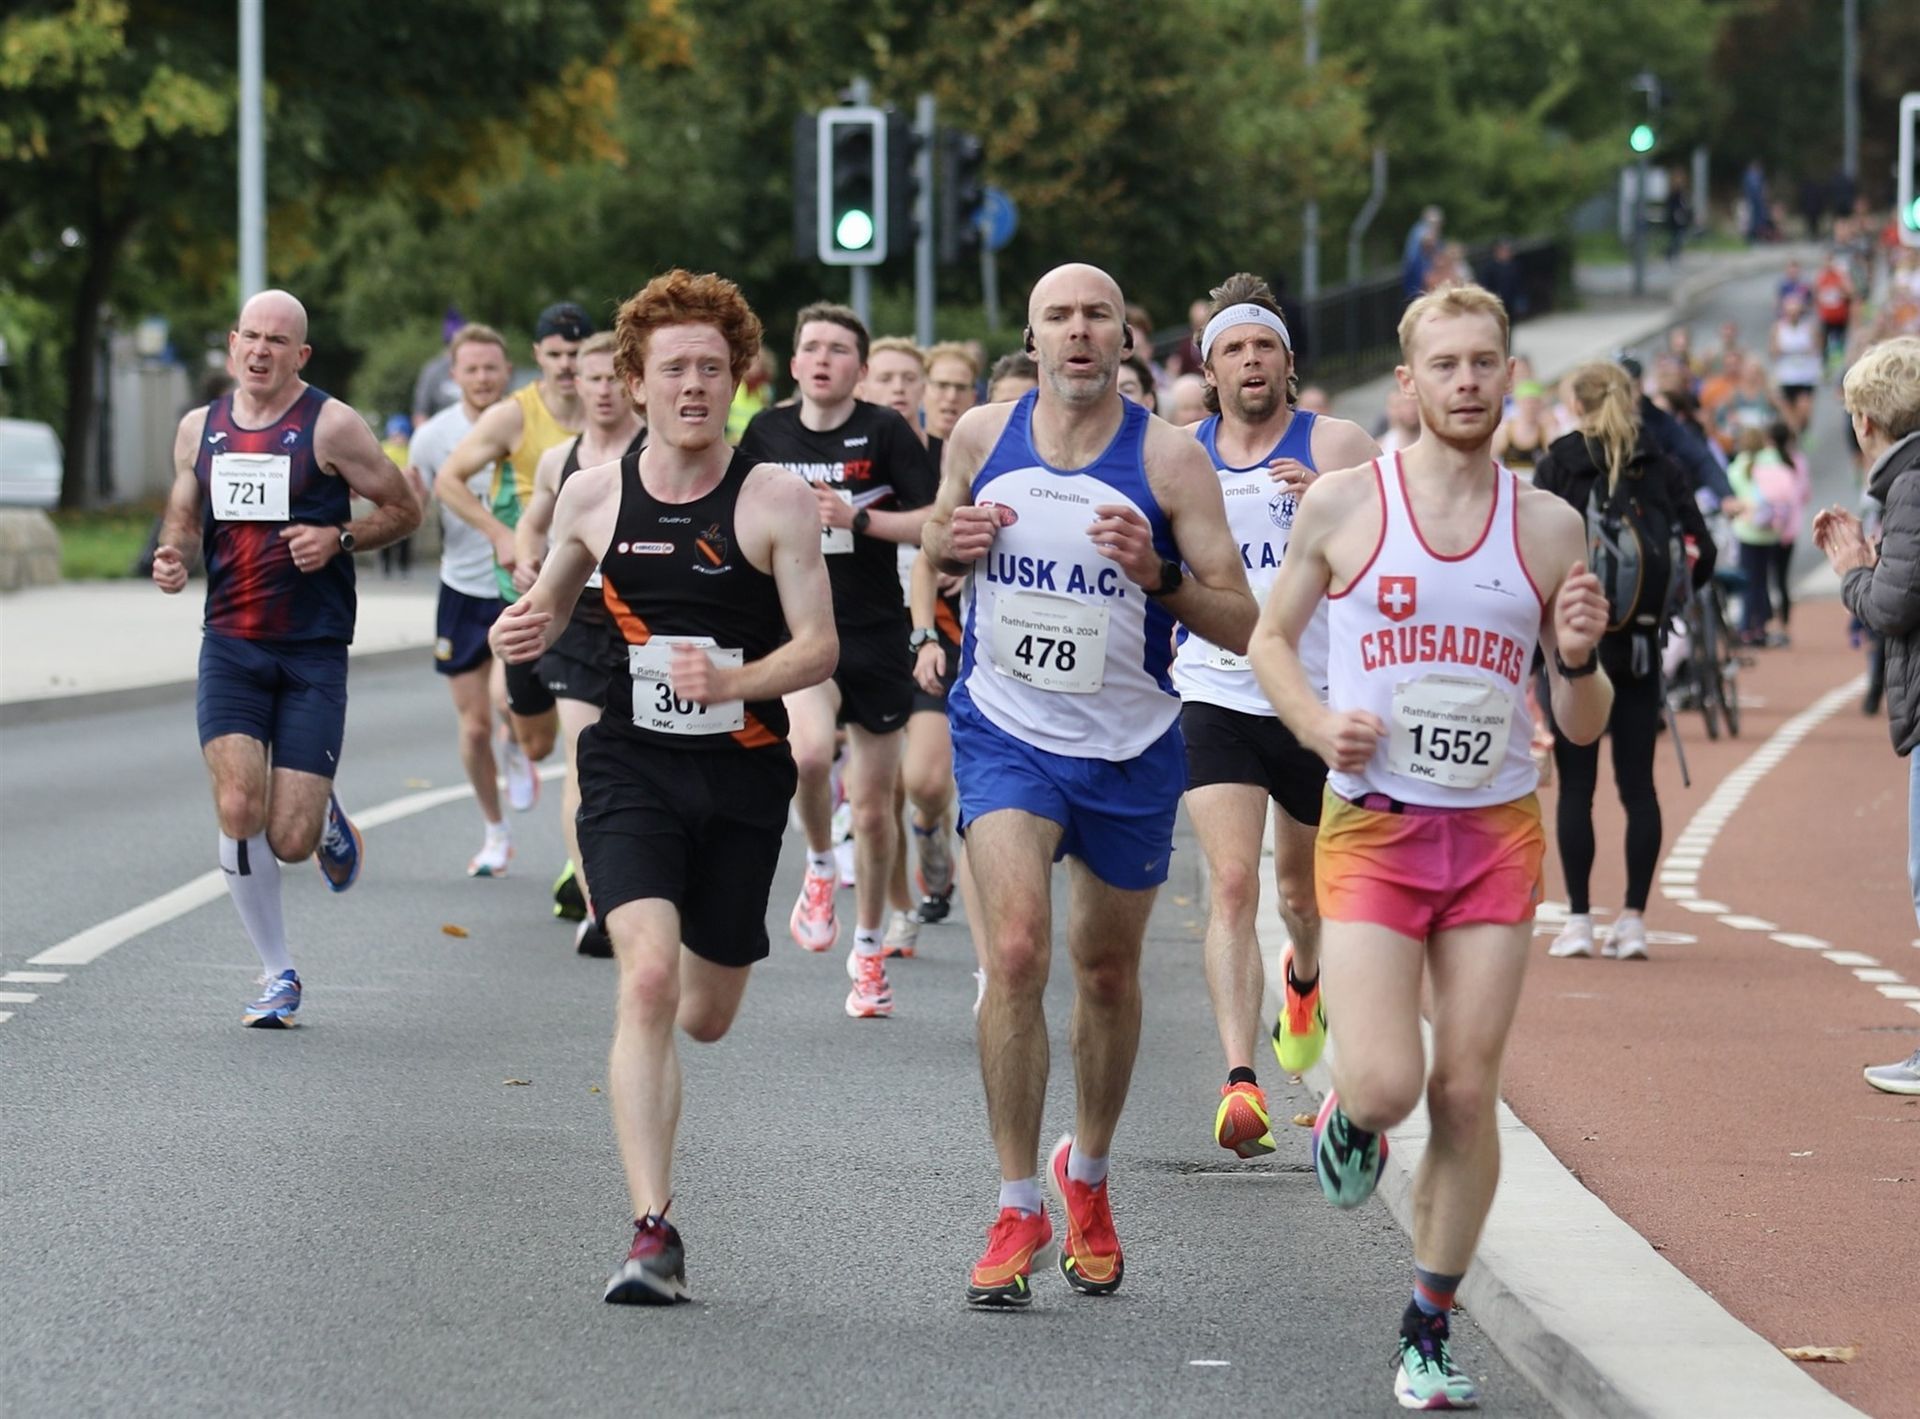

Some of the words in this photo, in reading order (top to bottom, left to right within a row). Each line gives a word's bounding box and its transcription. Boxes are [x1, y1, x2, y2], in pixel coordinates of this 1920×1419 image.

[228, 482, 265, 505] 721
[1029, 487, 1090, 505] O'Neills
[1224, 484, 1261, 497] oneills
[986, 551, 1058, 592] LUSK
[1066, 563, 1125, 598] A.C.
[1001, 615, 1060, 633] Rathfarnham
[1062, 626, 1074, 635] 5k
[1076, 627, 1099, 636] 2024
[1015, 634, 1076, 672] 478
[1220, 657, 1236, 667] DNG
[1360, 624, 1524, 686] CRUSADERS
[1012, 668, 1033, 682] DNG
[1402, 705, 1468, 722] Rathfarnham
[651, 718, 675, 730] DNG
[1408, 724, 1491, 766] 1552
[1410, 762, 1436, 778] DNG
